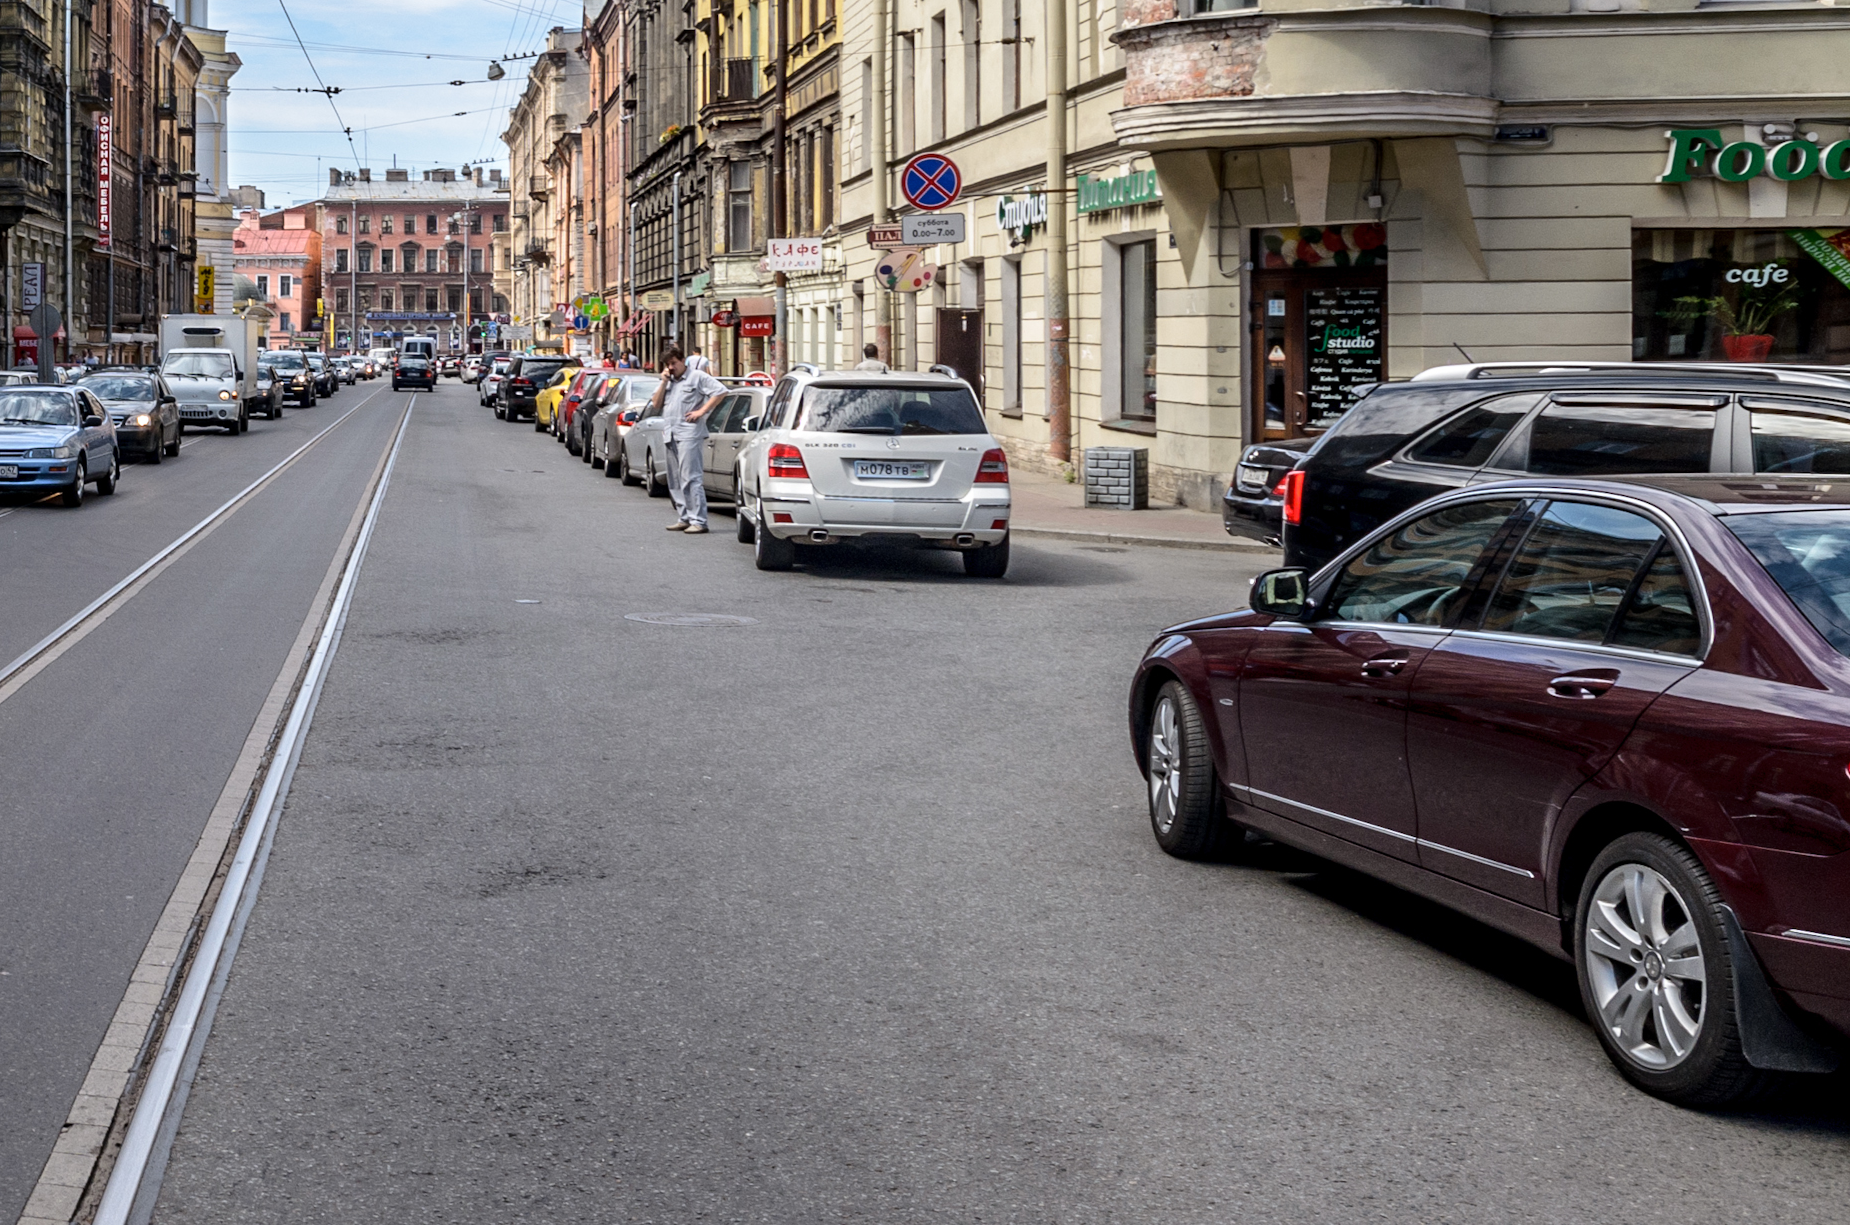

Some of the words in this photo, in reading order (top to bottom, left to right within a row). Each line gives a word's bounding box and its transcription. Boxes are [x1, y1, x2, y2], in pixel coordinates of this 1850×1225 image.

[99, 116, 109, 176] ОФИСНАЯ
[99, 180, 109, 231] МЕБЕЛЬ
[917, 219, 949, 227] суббота
[874, 231, 902, 241] ПАЛ
[25, 266, 37, 306] РЕАЛ
[1725, 263, 1788, 288] cafe
[19, 339, 38, 347] МЕБЕ
[1314, 324, 1360, 352] food
[1327, 335, 1375, 348] studio
